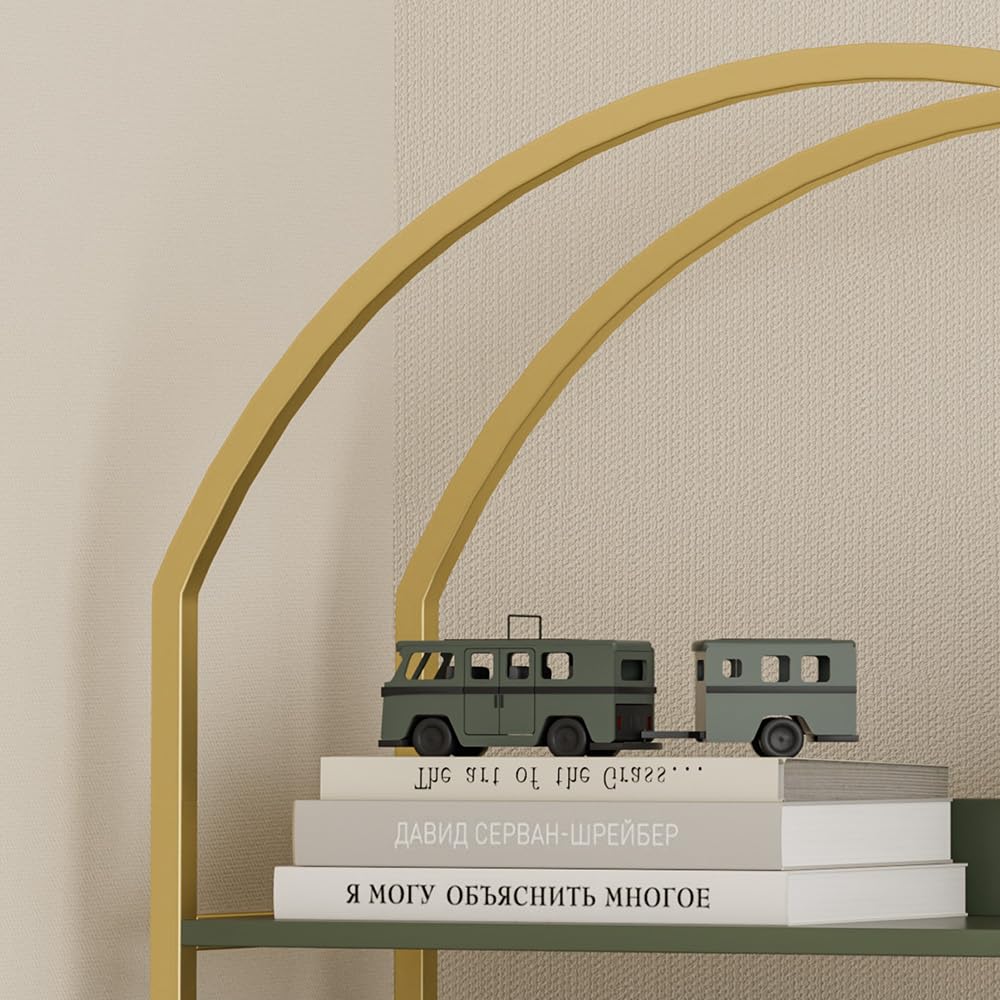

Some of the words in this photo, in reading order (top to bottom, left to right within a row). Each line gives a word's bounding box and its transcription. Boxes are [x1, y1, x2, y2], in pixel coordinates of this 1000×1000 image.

[394, 821, 469, 849] ДАВИД
[475, 818, 679, 847] СЕРВАН-ШРЕЙБЕР
[346, 883, 360, 904] Я
[369, 884, 435, 905] МОГУ
[446, 885, 596, 907] ОБЪЯСНИТЬ
[605, 887, 710, 909] МНОГОЕ
